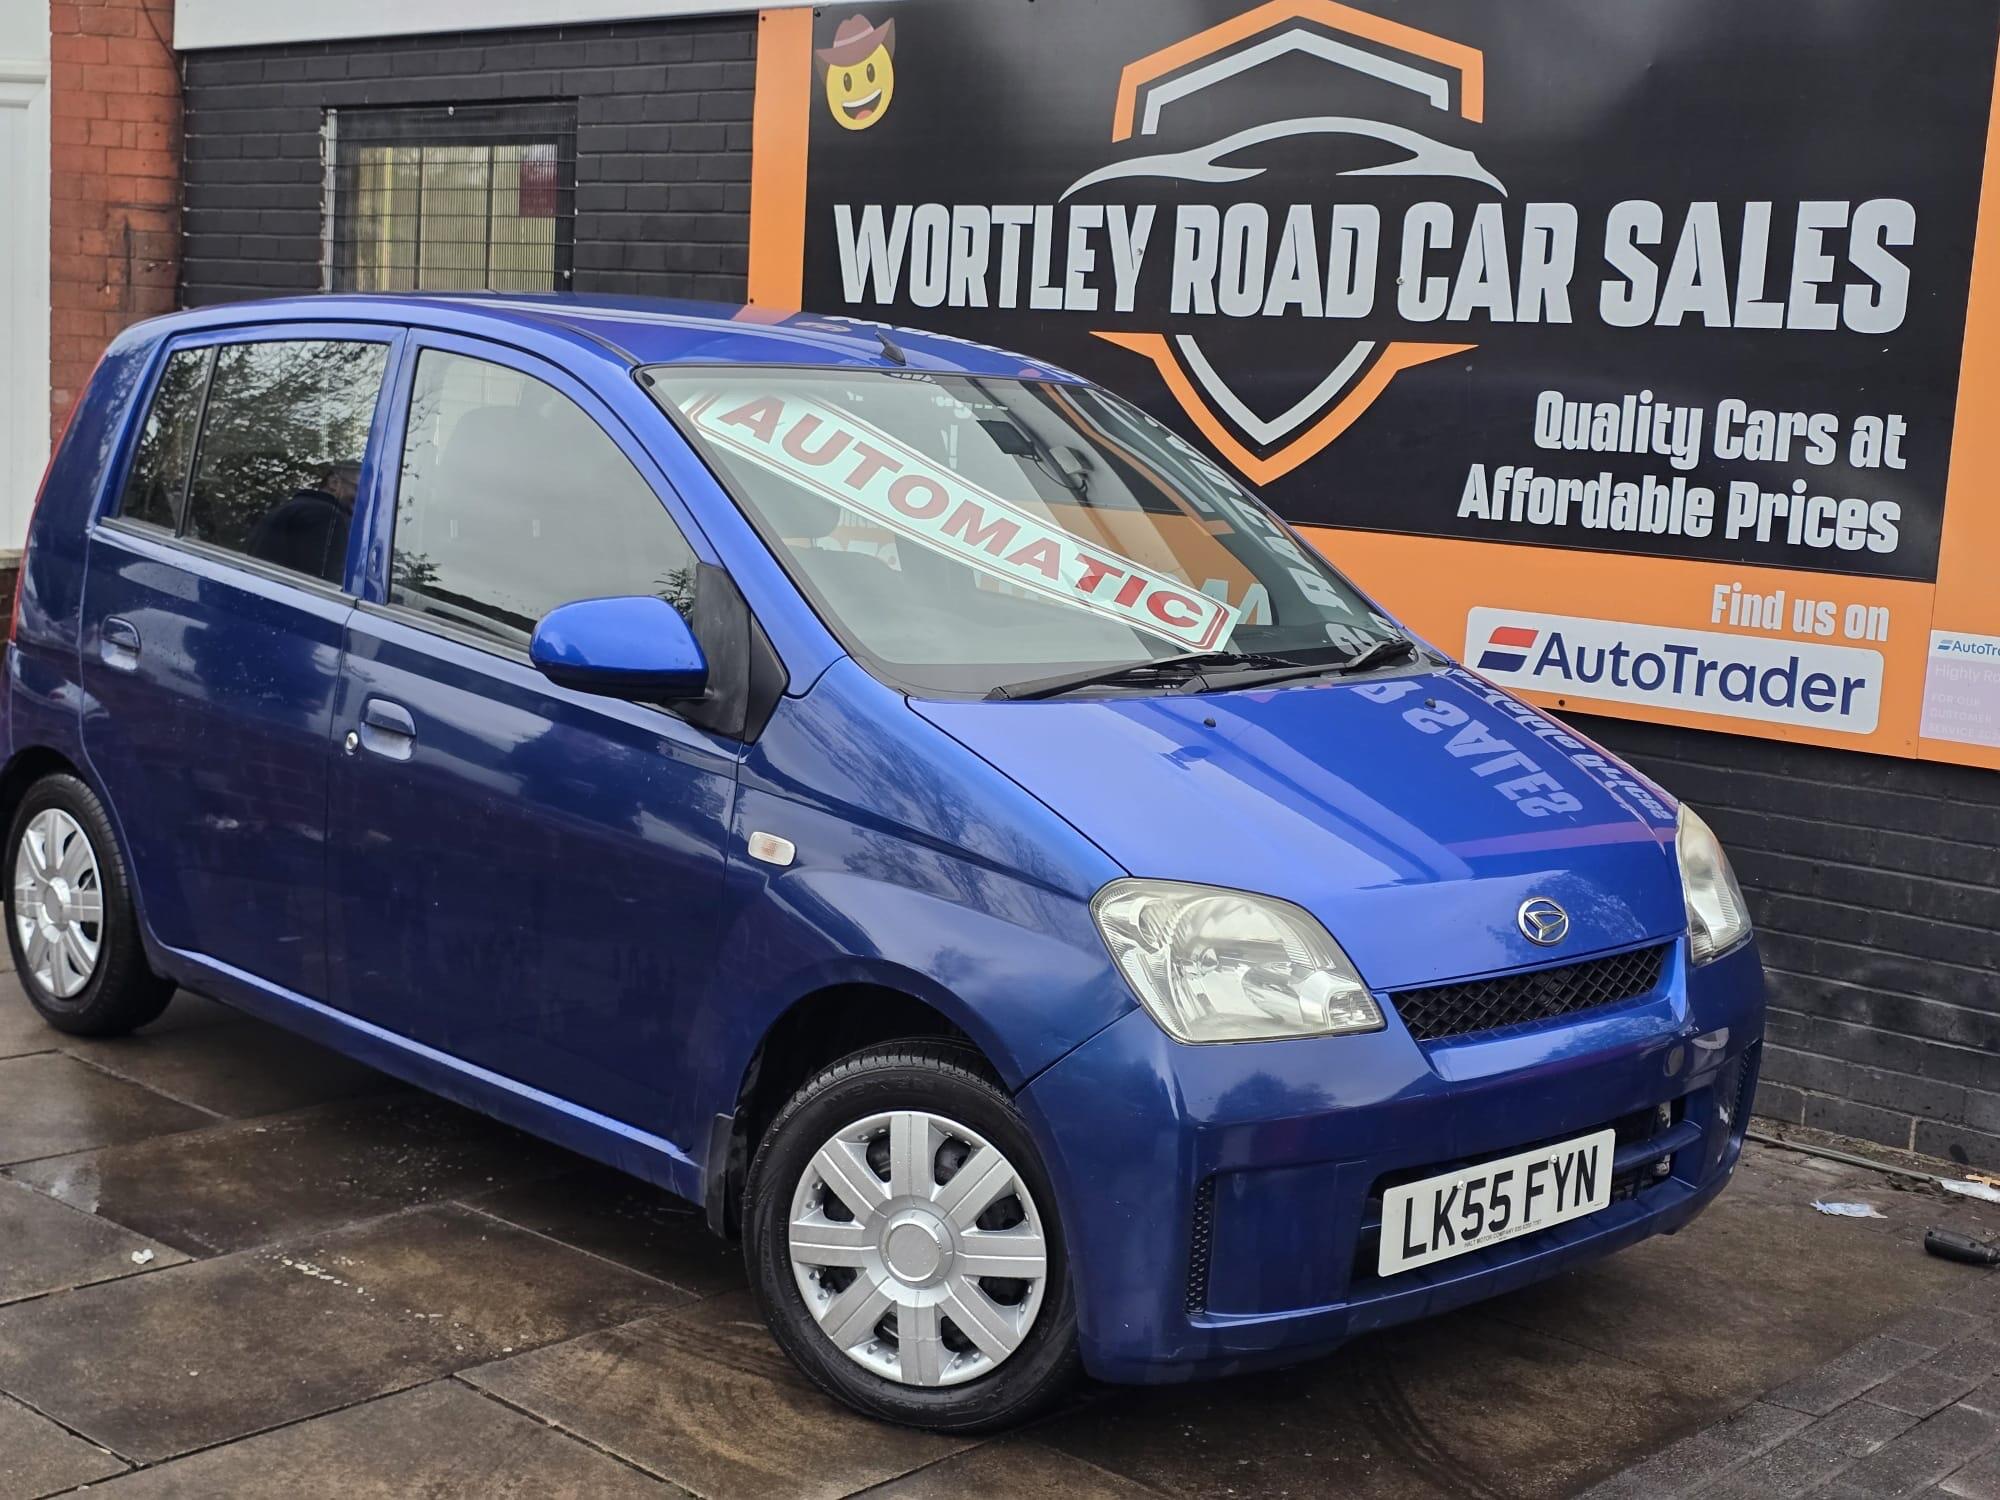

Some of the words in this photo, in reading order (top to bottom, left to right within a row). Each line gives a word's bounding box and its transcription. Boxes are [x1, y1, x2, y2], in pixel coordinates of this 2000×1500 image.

[833, 203, 1157, 313] WORTLEY
[1170, 202, 1382, 318] ROAD
[1397, 201, 1579, 324] CAR
[1599, 198, 1917, 334] SALES
[1534, 389, 1703, 470] Quality
[1713, 398, 1839, 466] Cars
[1849, 414, 1908, 470] at
[716, 394, 1203, 629] AUTOMATIC
[1456, 463, 1715, 538] Affordable
[1725, 479, 1901, 554] Prices
[1711, 582, 1786, 631] Find
[1792, 600, 1837, 637] us
[1844, 604, 1890, 642] on
[1533, 632, 1866, 716] AutoTrader
[1935, 664, 1981, 682] Highly
[1402, 1169, 1514, 1260] LK55
[1524, 1145, 1599, 1223] FYN
